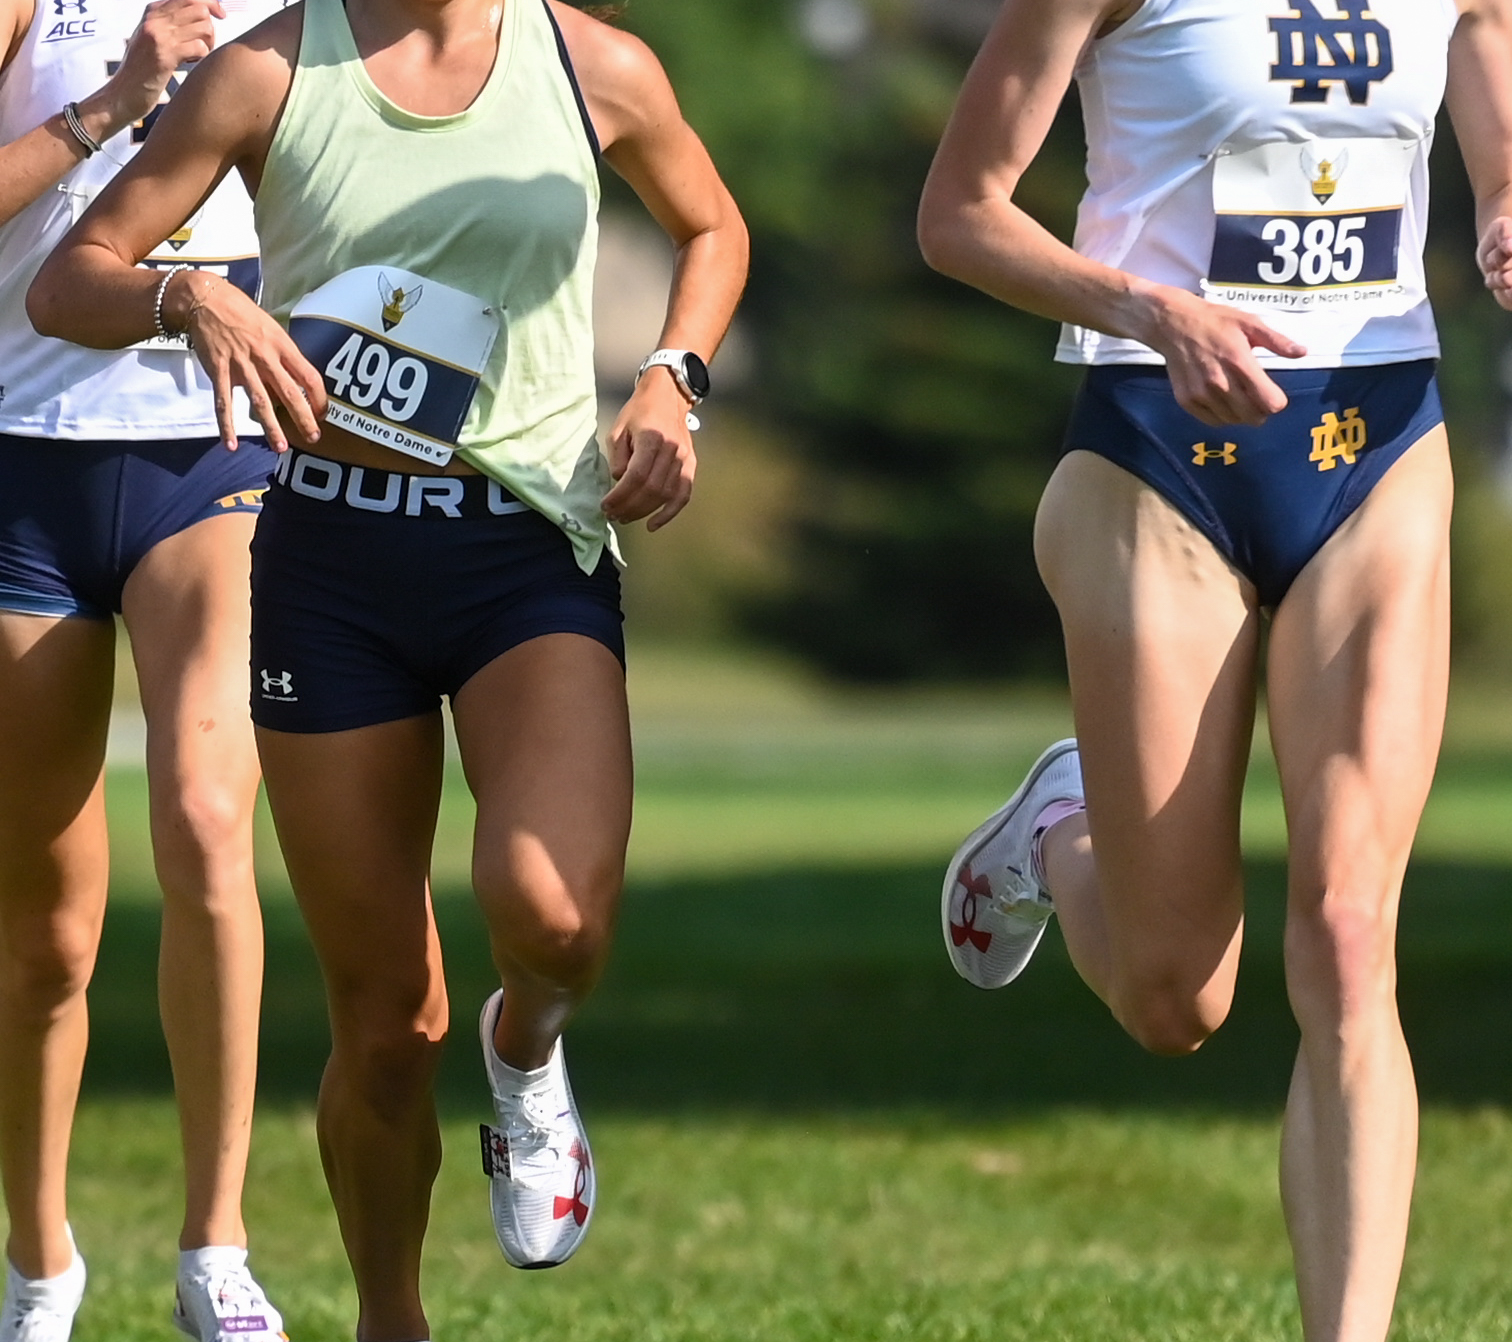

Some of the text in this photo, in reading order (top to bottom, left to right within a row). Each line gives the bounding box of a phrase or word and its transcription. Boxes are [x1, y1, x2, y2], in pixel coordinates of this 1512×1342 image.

[45, 18, 97, 39] ACC
[1257, 215, 1368, 285] 385
[1226, 290, 1384, 306] University of Notre Dame
[324, 332, 429, 422] 499
[342, 413, 433, 455] of Notre Dame
